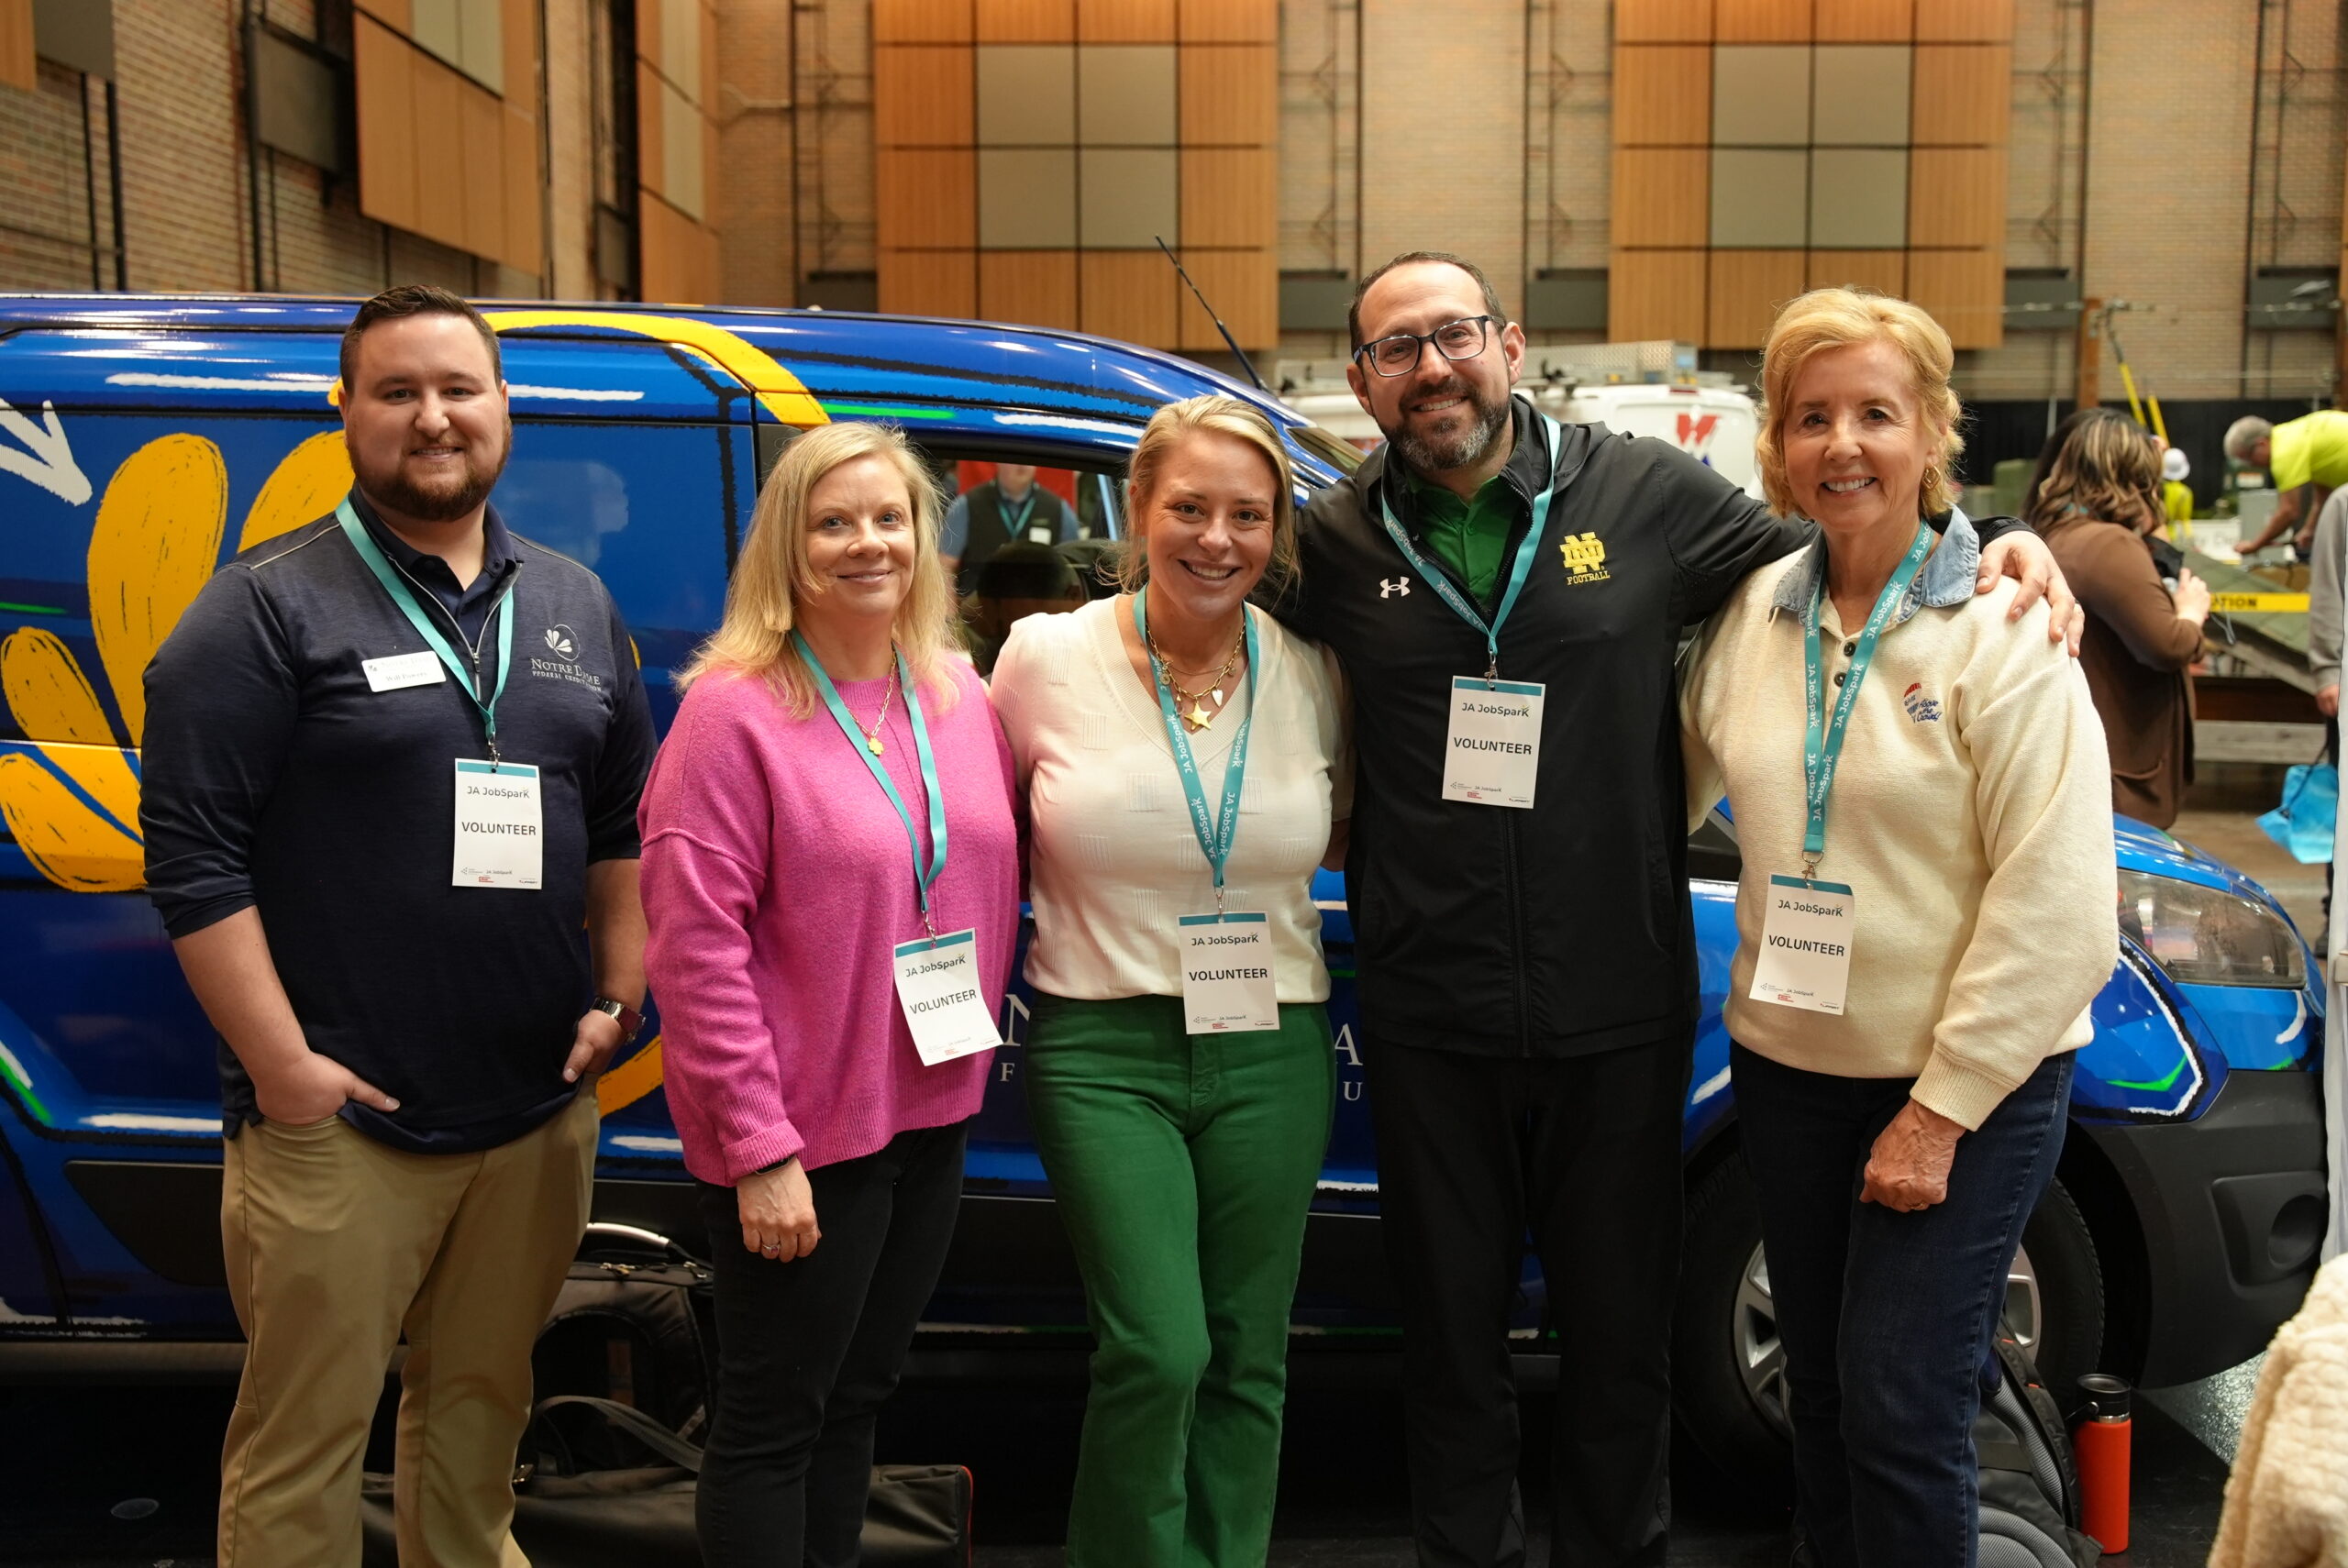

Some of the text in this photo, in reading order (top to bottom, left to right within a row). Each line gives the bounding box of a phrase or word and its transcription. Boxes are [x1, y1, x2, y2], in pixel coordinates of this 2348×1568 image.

[1567, 570, 1611, 586] FOOTBALL
[1866, 624, 1878, 639] JA
[530, 657, 573, 674] NOTRE
[1808, 663, 1815, 678] JA
[532, 670, 561, 679] FEDERAL
[1461, 702, 1475, 712] JA
[1834, 714, 1844, 729] JA
[1454, 737, 1532, 755] VOLUNTEER
[1183, 760, 1192, 774] JA
[467, 786, 480, 795] JA
[1225, 791, 1235, 805] JA
[461, 821, 537, 835] VOLUNTEER
[1208, 846, 1217, 859] JA
[1778, 900, 1791, 910] JA
[1191, 937, 1205, 946] JA
[1768, 934, 1844, 956] VOLUNTEER
[905, 967, 918, 977] JA
[1189, 968, 1268, 981] VOLUNTEER
[910, 988, 977, 1014] VOLUNTEER
